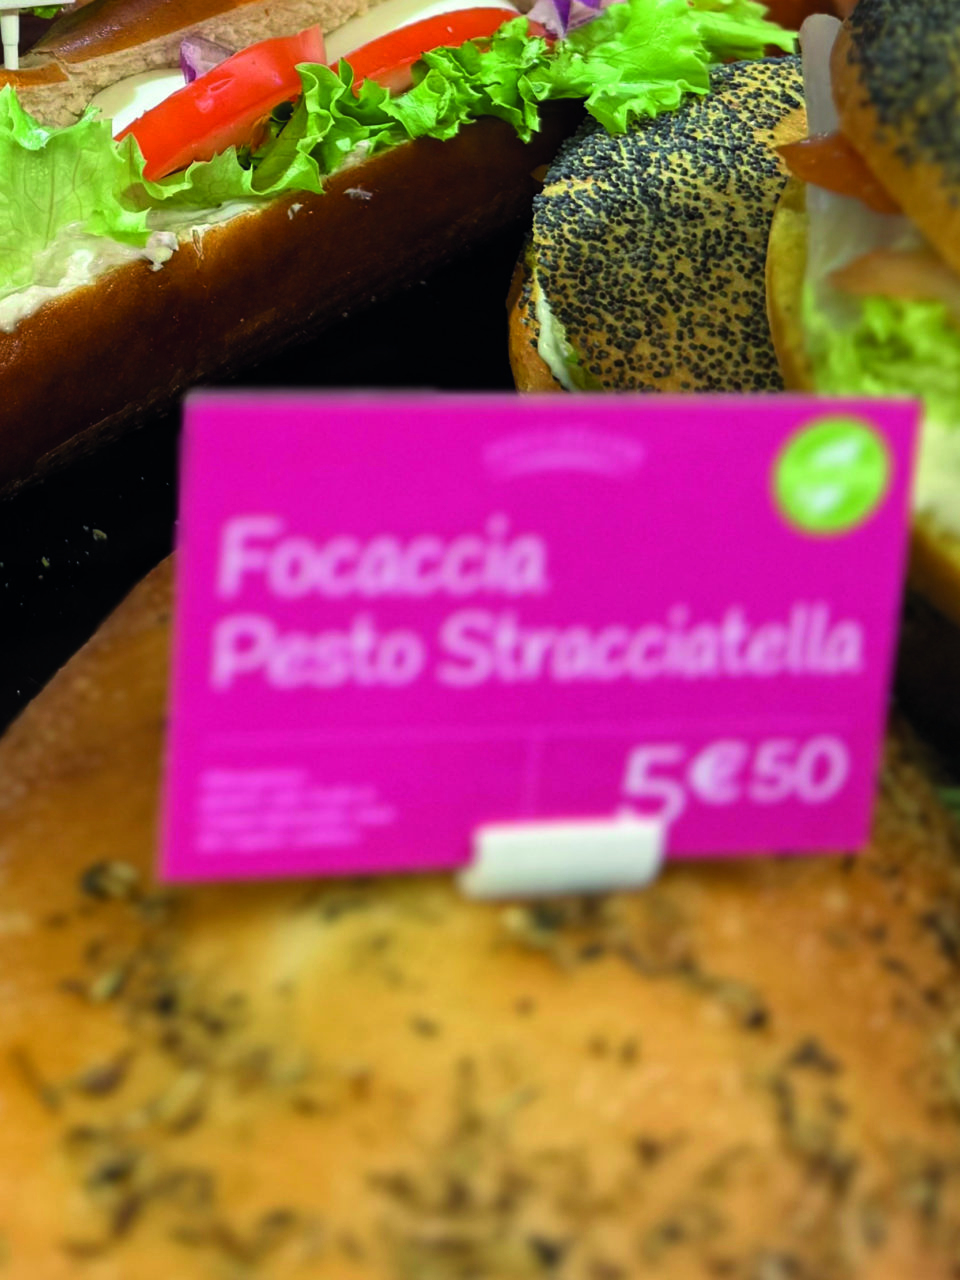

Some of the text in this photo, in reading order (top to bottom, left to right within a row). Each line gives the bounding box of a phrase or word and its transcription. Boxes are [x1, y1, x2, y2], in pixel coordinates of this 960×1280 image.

[215, 513, 549, 600] Focaccia
[207, 601, 865, 691] Pesto Stracciatella
[618, 736, 851, 821] 5€50
